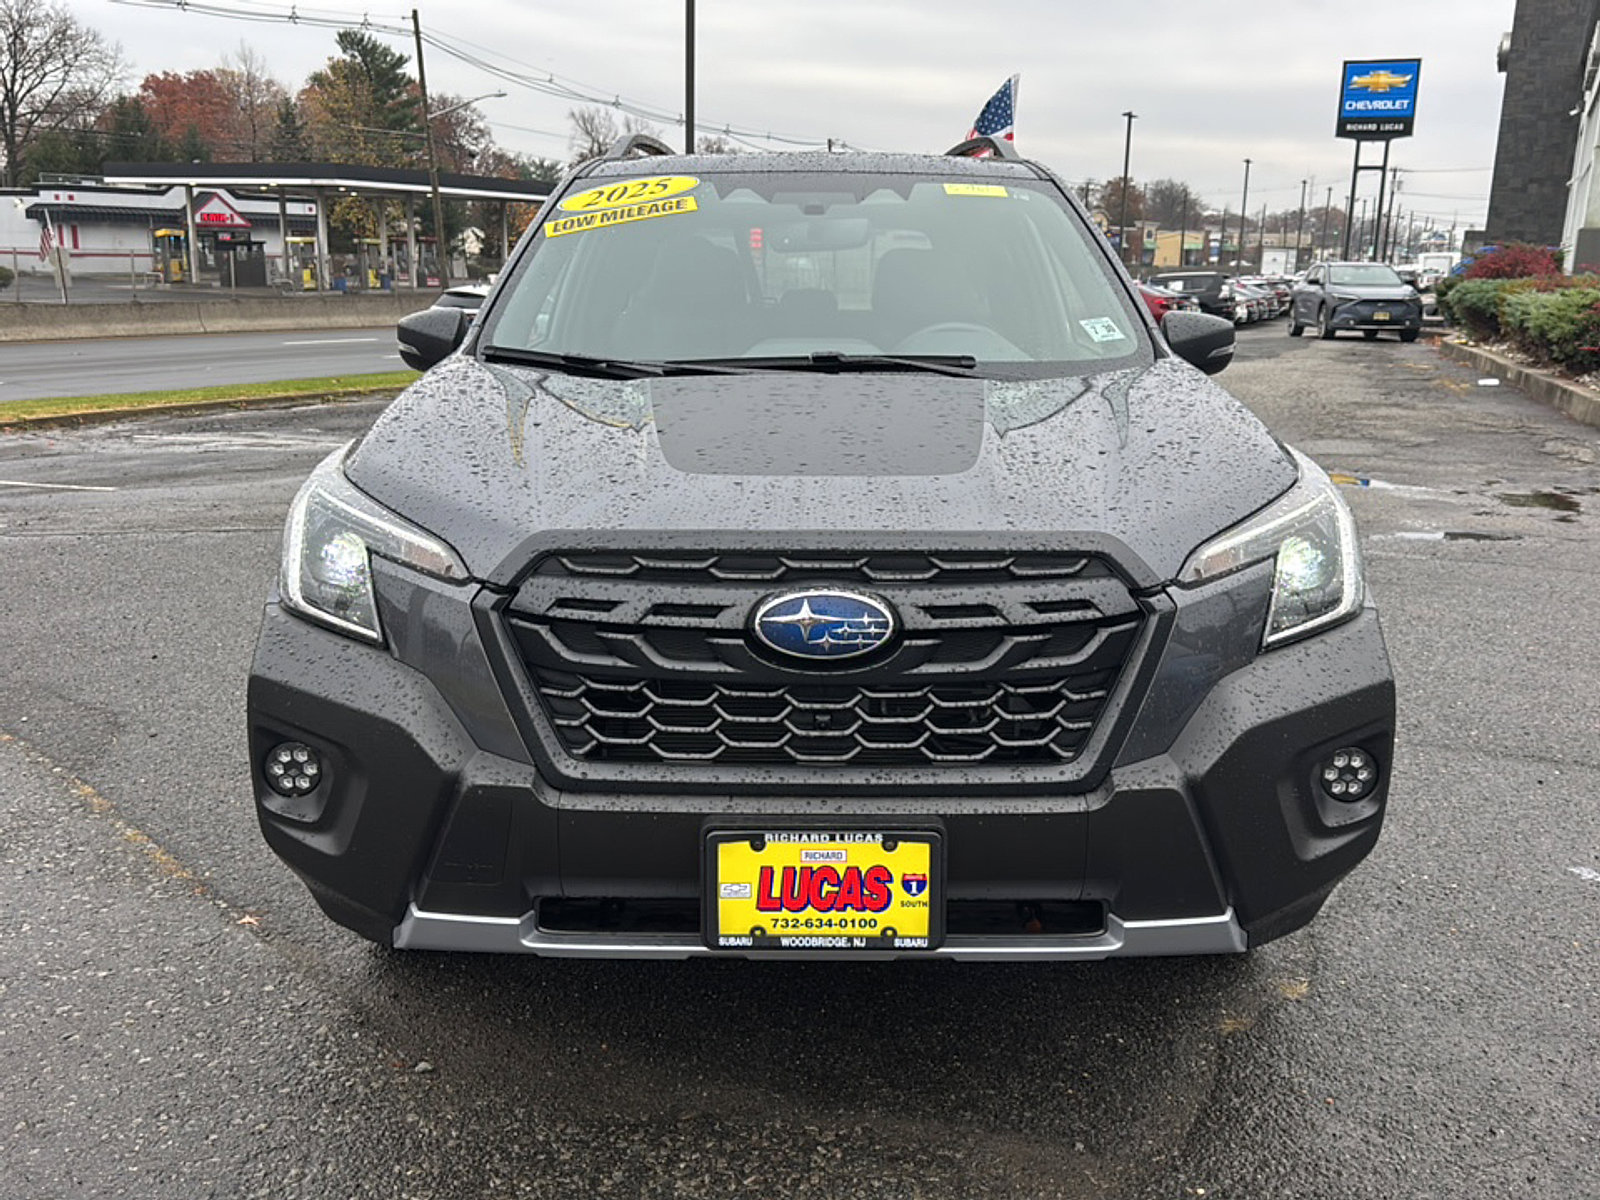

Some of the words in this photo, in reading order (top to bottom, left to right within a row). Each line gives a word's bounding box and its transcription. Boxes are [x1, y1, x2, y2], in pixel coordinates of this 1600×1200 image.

[1345, 99, 1410, 111] CHEVROLET
[1346, 123, 1378, 131] RICHARD
[1380, 123, 1404, 131] LUCAS
[582, 178, 672, 207] 2025
[553, 215, 597, 232] LOW
[600, 199, 688, 222] MILEAGE
[764, 833, 829, 843] RICHARD
[836, 833, 883, 843] LUCAS
[804, 851, 843, 860] RICHARD
[756, 865, 894, 913] LUCAS
[909, 881, 919, 895] 1
[900, 900, 928, 908] SOUTH
[770, 918, 878, 929] 732-634-0100
[719, 936, 753, 946] SUBARU
[853, 937, 866, 947] NJ
[894, 937, 928, 947] SUBARU
